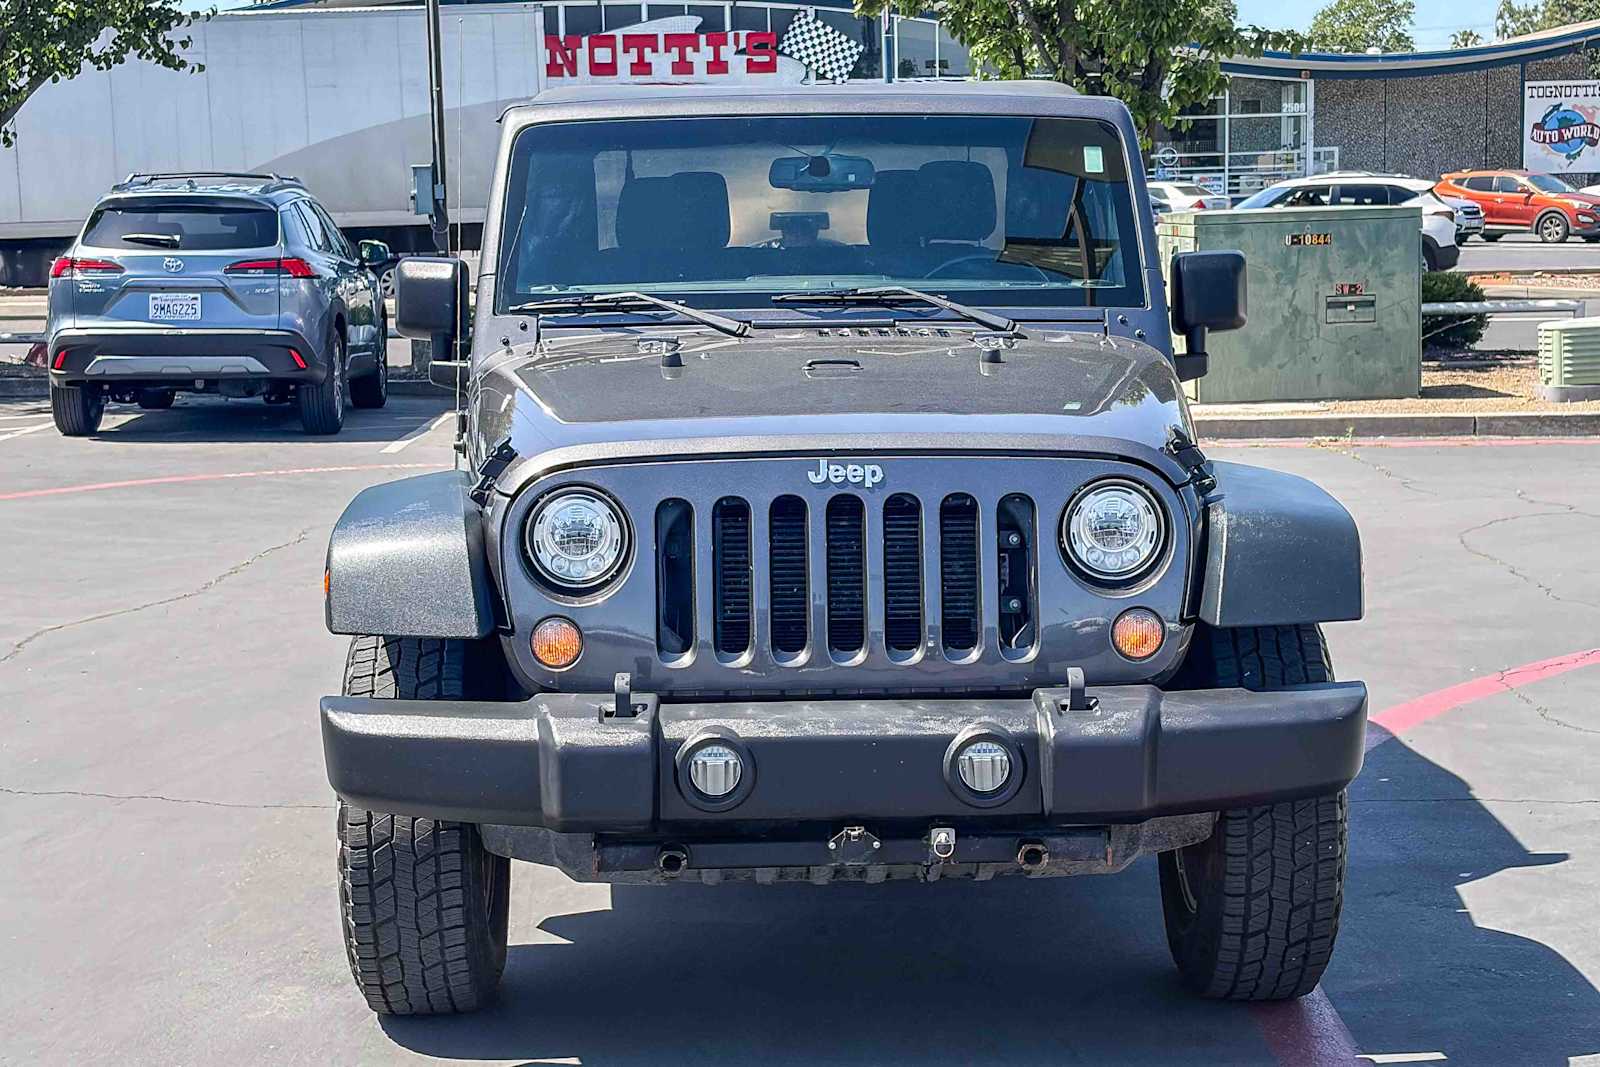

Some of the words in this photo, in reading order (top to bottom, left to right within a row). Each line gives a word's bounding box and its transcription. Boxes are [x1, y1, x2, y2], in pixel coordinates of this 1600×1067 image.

[1528, 82, 1600, 98] TOGNOTTI'
[1532, 129, 1558, 142] AUTO
[1562, 124, 1600, 140] WORLD
[1285, 234, 1331, 246] U-10844
[153, 303, 197, 315] 9MAG225
[807, 459, 883, 488] Jeep
